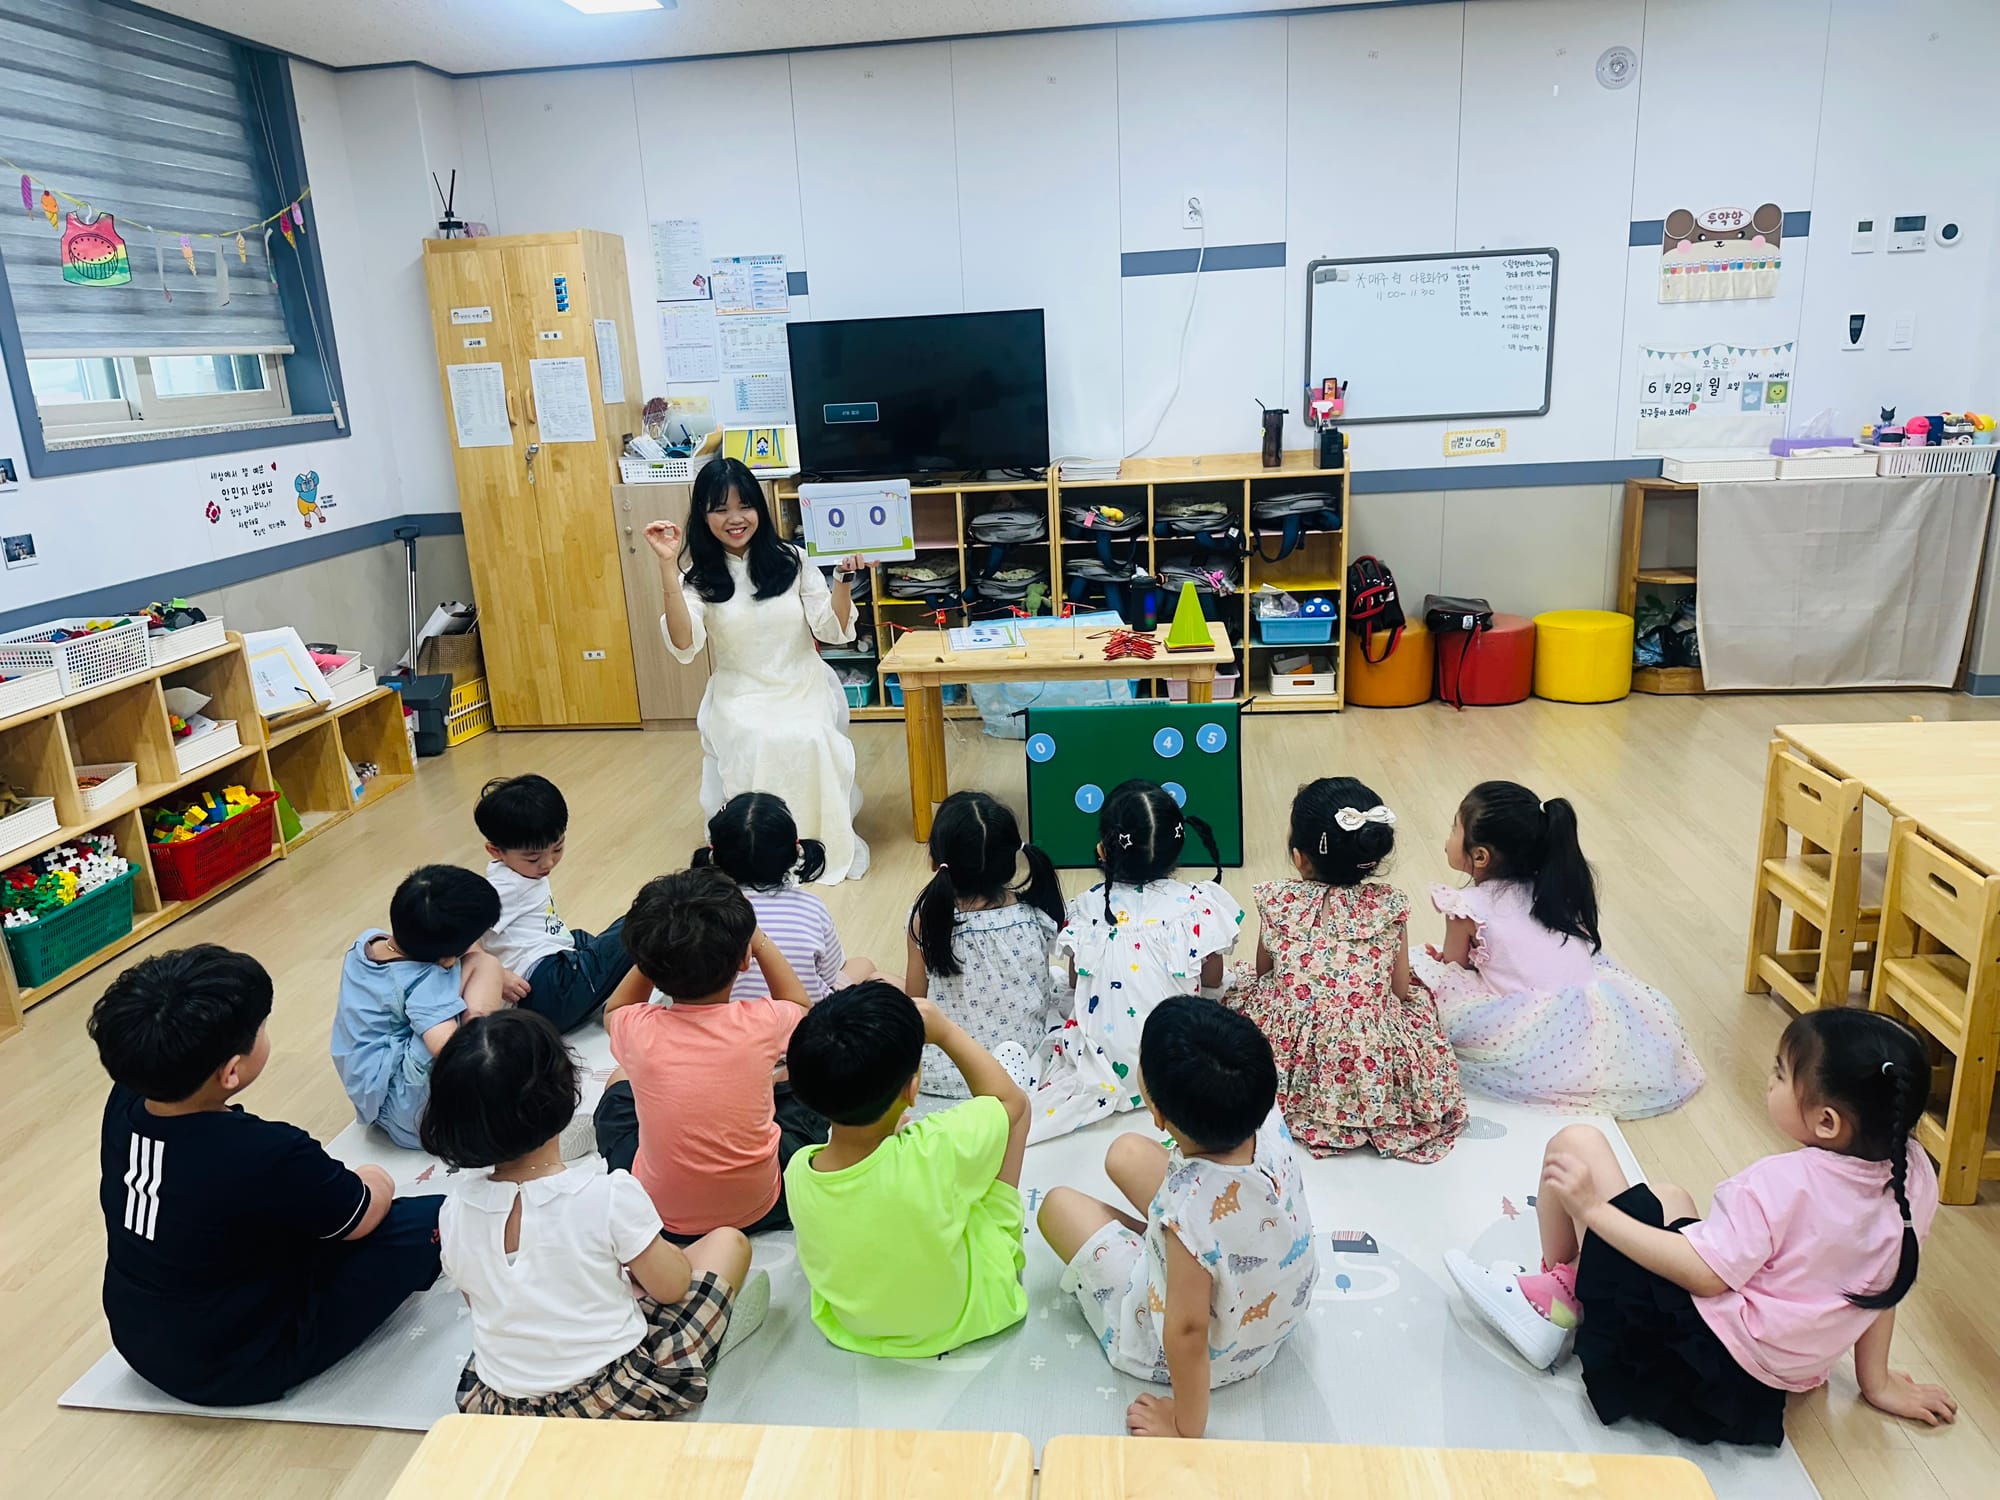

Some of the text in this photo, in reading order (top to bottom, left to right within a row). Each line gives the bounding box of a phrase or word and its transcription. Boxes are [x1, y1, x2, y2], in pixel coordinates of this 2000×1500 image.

[1648, 377, 1740, 396] 6 월 29 일 월 요일
[1640, 408, 1666, 418] 친구들아
[210, 471, 238, 481] 세상에서
[253, 465, 264, 474] 예쁜
[222, 481, 273, 501] 안민지 선생님
[828, 506, 886, 528] 0 0
[1035, 732, 1218, 754] 0 4 5
[1085, 793, 1092, 805] 1
